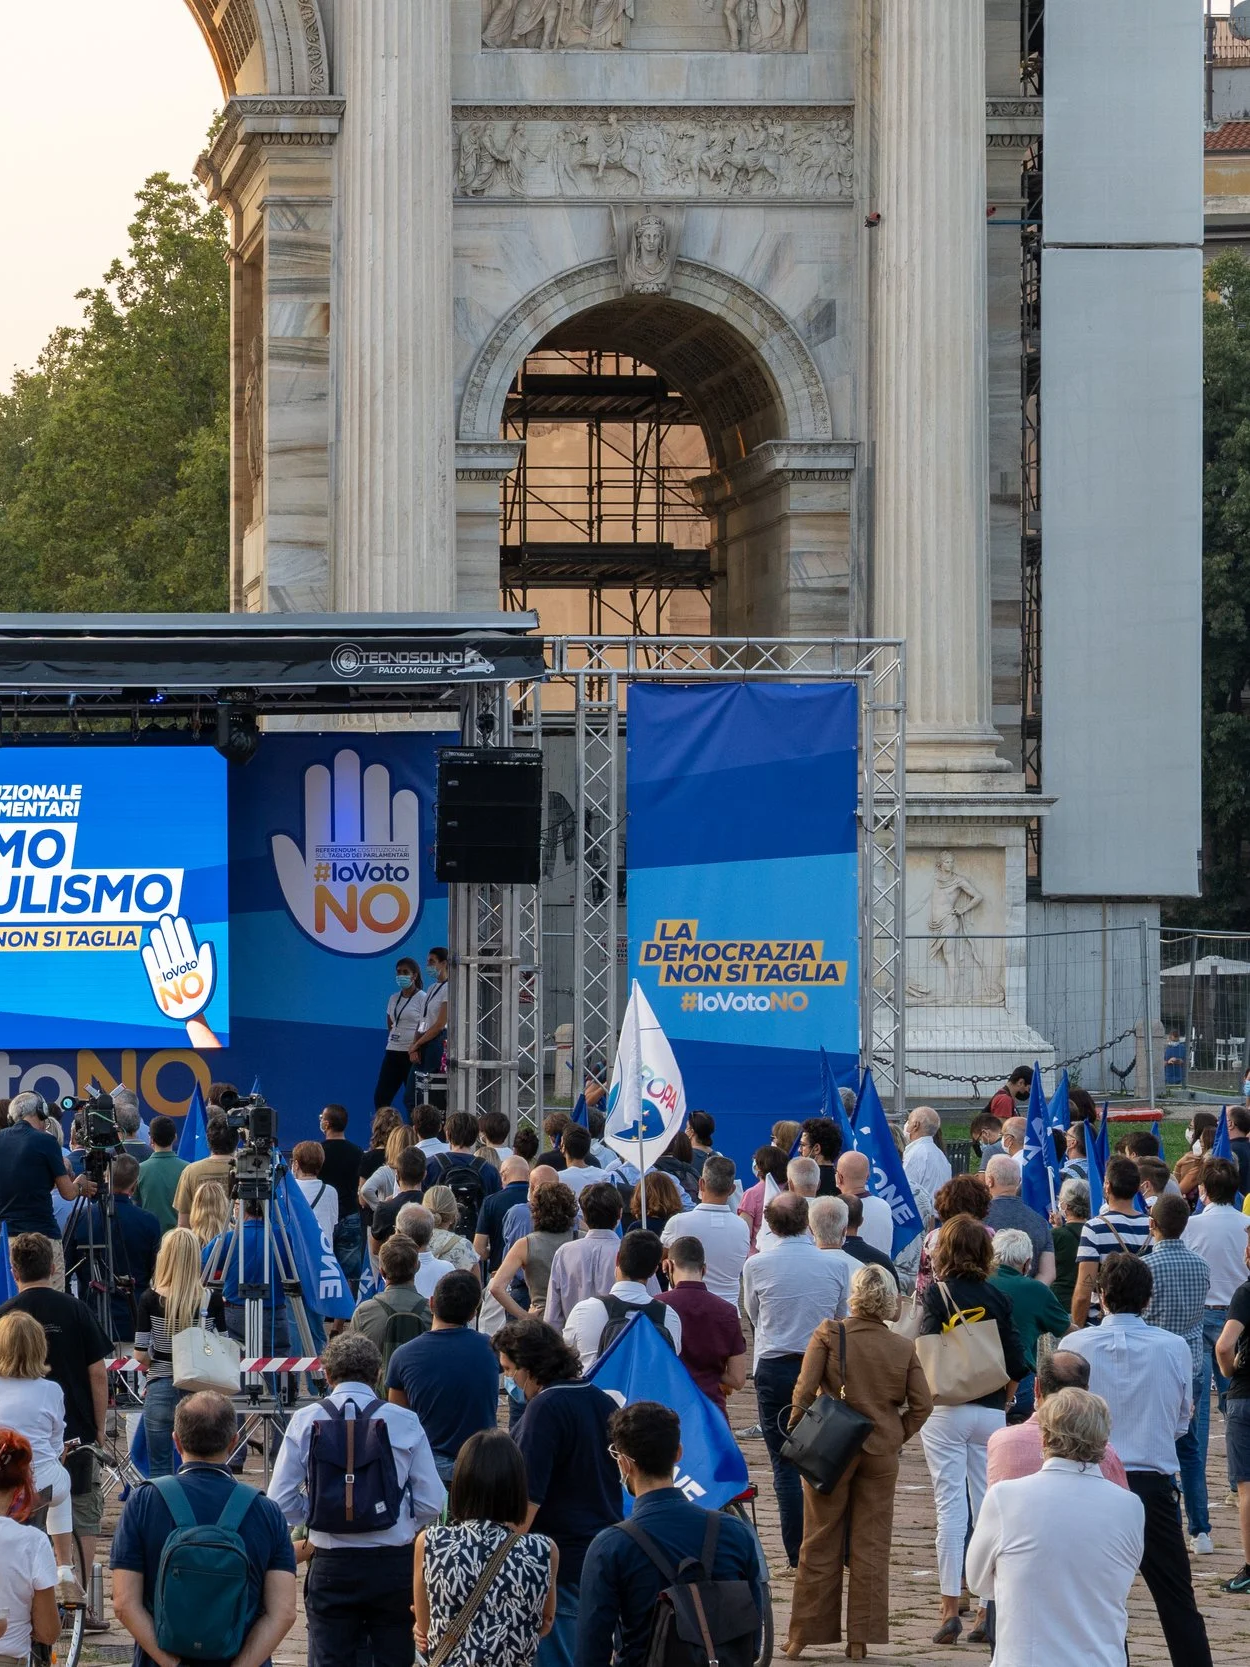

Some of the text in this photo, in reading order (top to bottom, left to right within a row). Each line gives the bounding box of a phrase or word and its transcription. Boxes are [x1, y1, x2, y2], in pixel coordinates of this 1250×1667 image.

[359, 651, 463, 664] TECNOSOUND
[314, 862, 409, 882] #IoVoto
[315, 884, 410, 934] NO
[42, 931, 62, 947] SI
[66, 931, 138, 947] TAGLIA
[659, 922, 693, 941] LA
[644, 942, 817, 962] DEMOCRAZIA
[664, 963, 840, 983] NON SI TAGLIA
[159, 971, 205, 1011] NO
[681, 991, 809, 1012] #IoVotoNO
